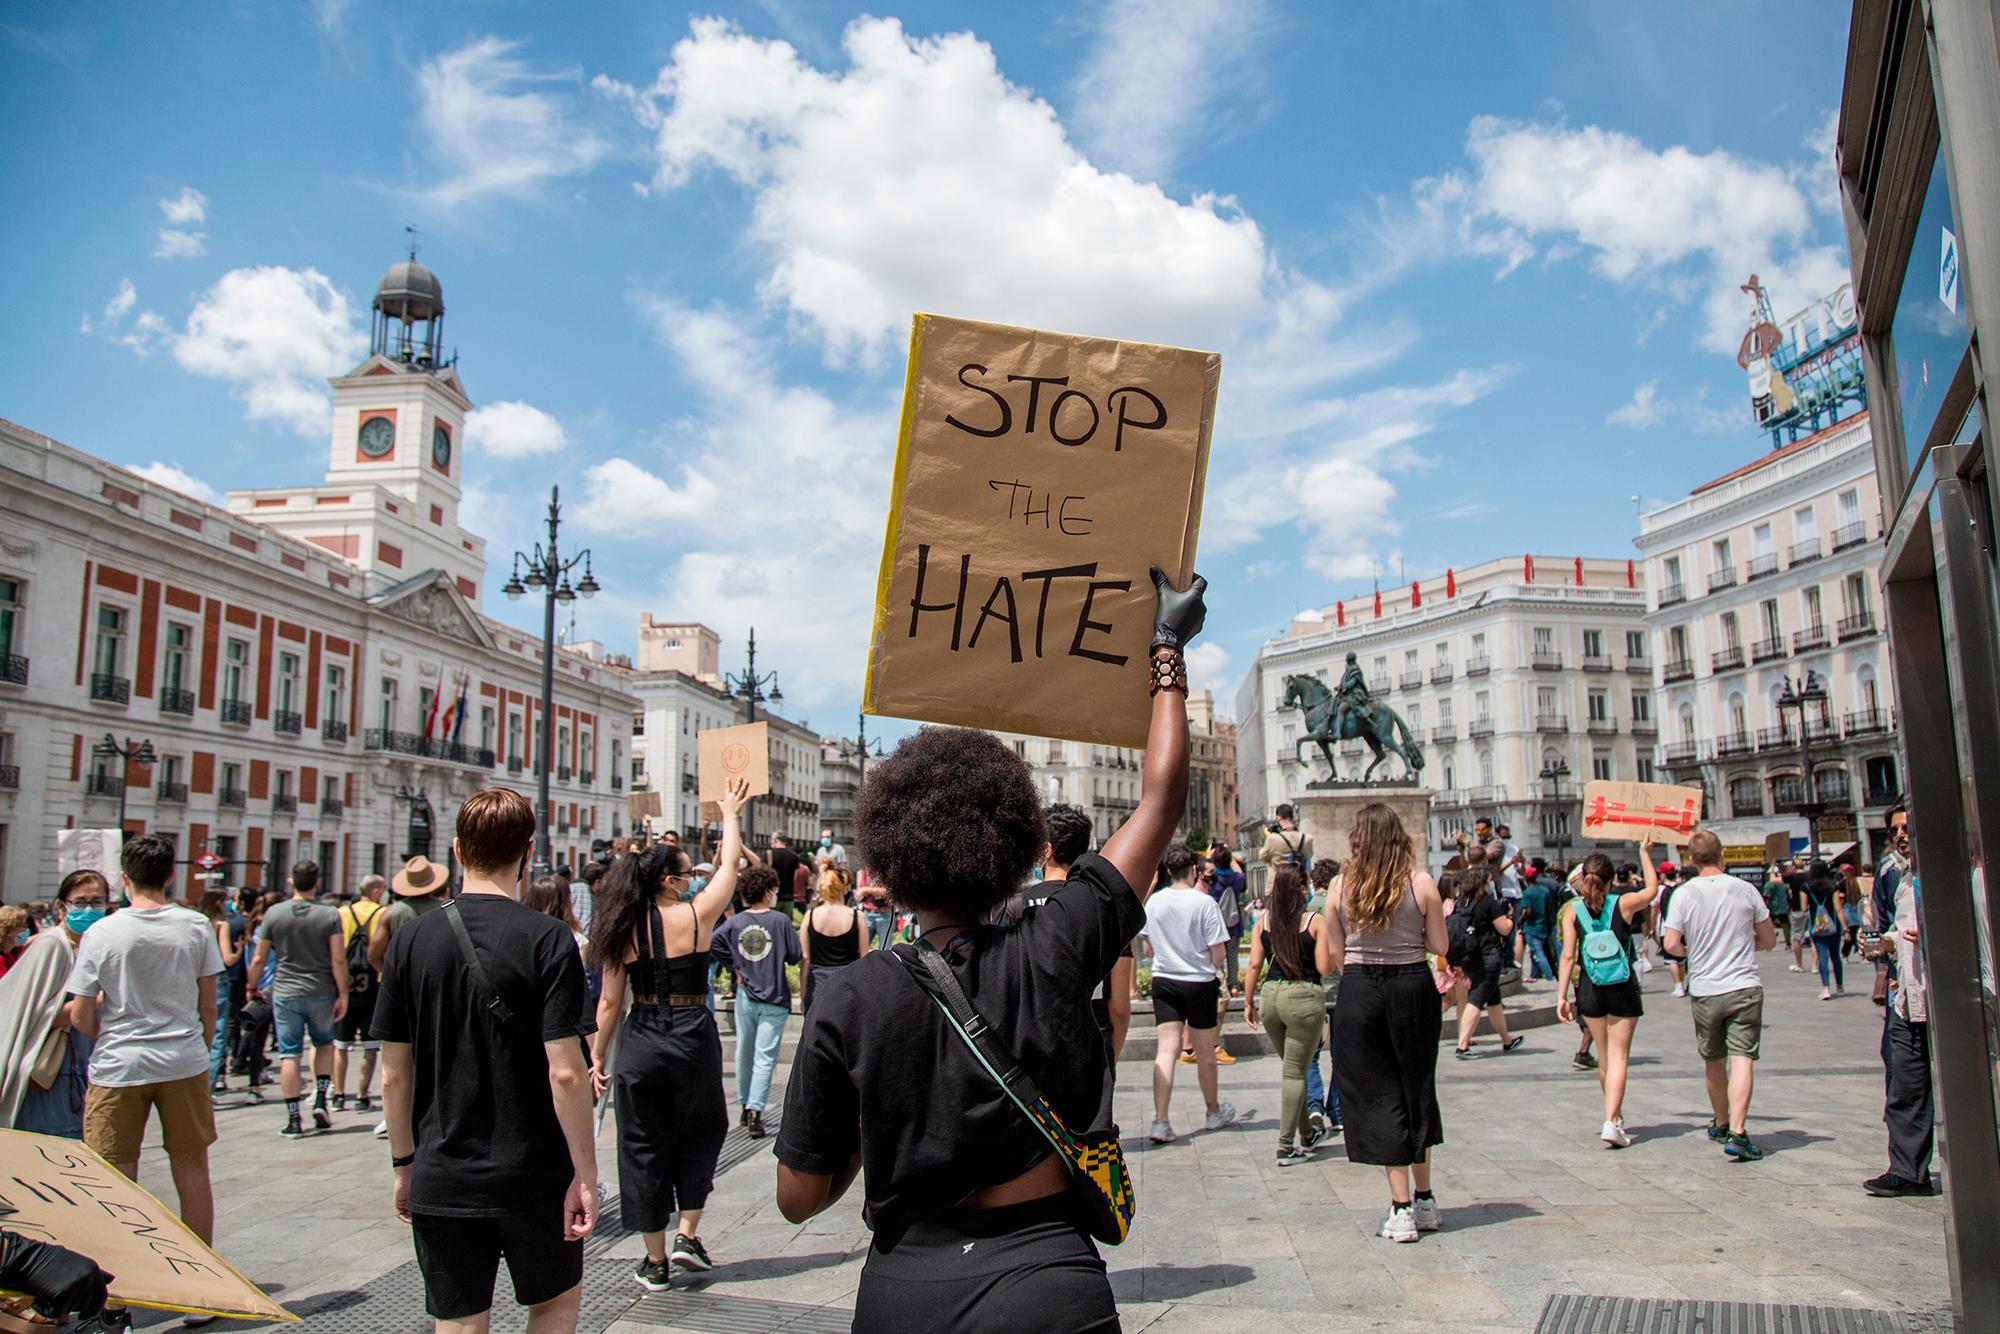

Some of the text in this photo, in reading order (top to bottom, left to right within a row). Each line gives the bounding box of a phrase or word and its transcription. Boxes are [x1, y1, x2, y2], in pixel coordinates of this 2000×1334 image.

[944, 363, 1168, 452] STOP
[988, 478, 1093, 536] THE
[908, 544, 1132, 667] HATE
[34, 1145, 222, 1279] SILENCE
